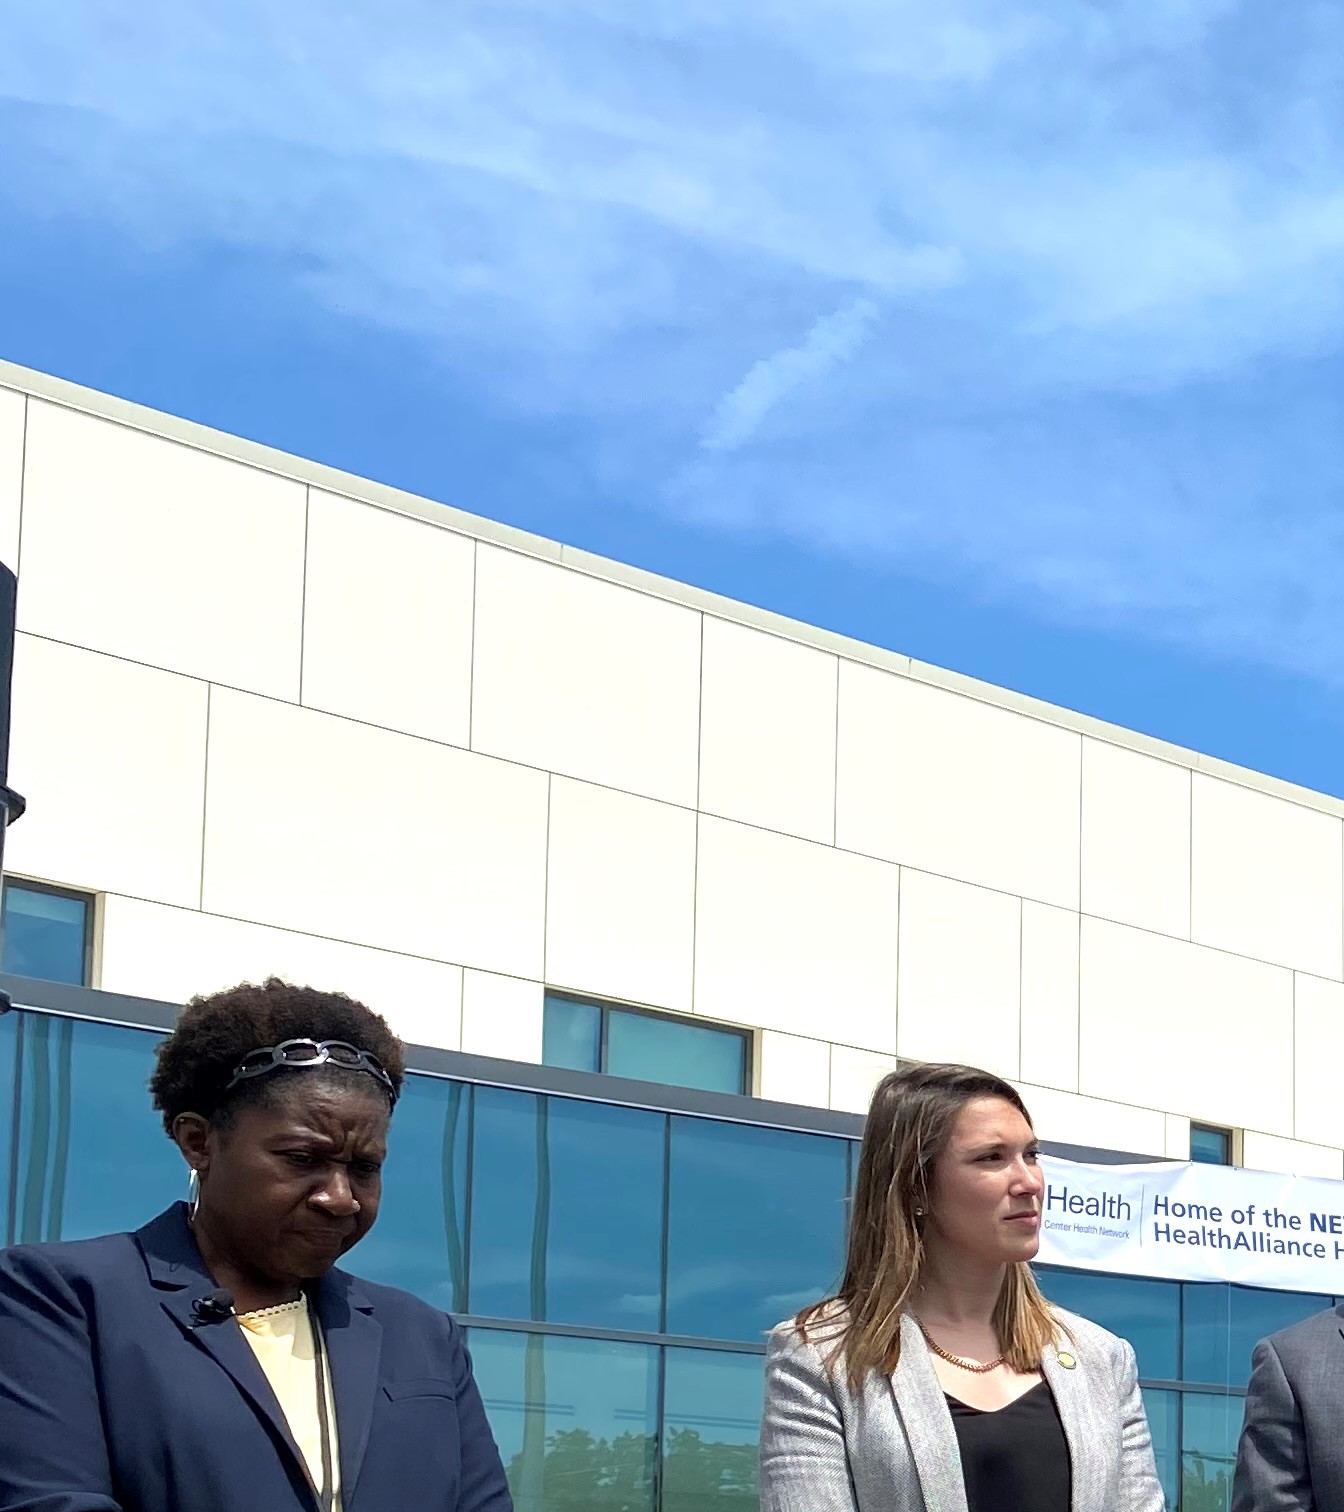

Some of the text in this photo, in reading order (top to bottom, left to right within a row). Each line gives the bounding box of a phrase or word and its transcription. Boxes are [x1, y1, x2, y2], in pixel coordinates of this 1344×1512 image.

[1047, 1185, 1131, 1221] Health
[1154, 1195, 1222, 1222] Home
[1231, 1205, 1255, 1224] of
[1262, 1207, 1301, 1231] the
[1044, 1219, 1130, 1239] Center Health Network
[1154, 1222, 1326, 1258] HealthAlliance
